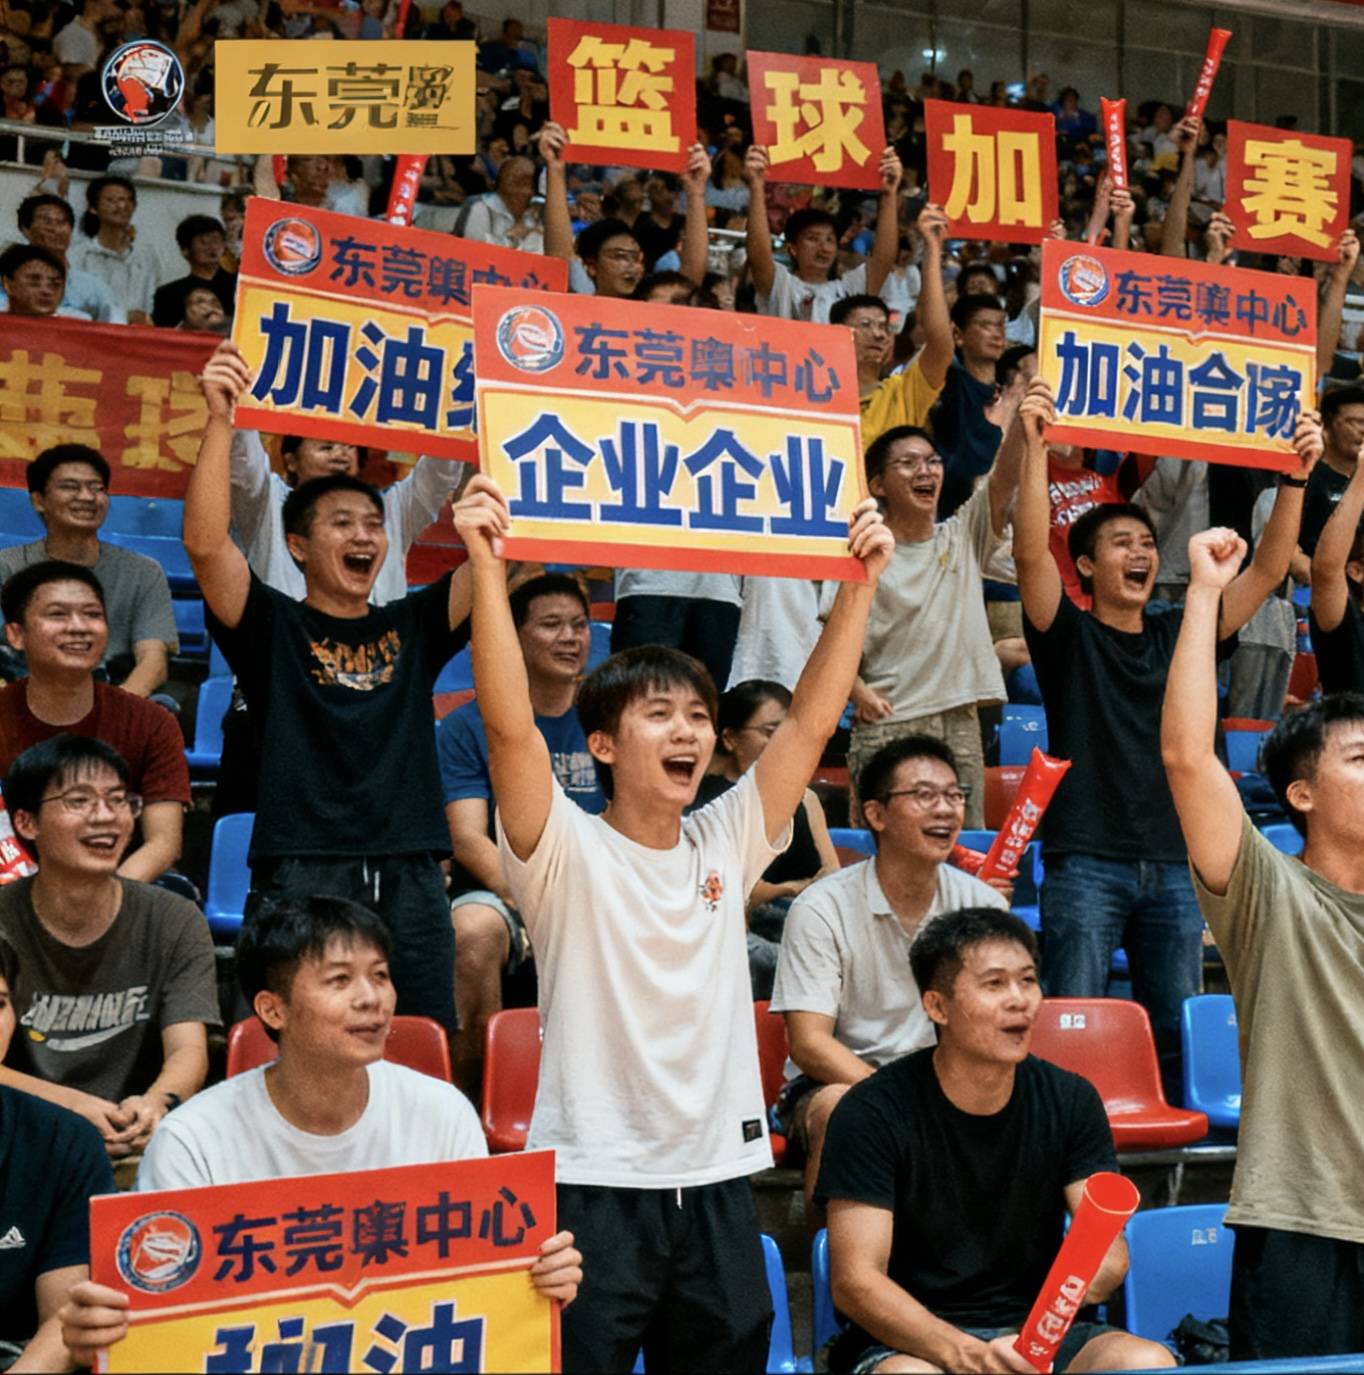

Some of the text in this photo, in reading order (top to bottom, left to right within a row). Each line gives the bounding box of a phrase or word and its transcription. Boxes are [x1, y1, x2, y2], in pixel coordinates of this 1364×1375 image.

[566, 35, 681, 154] 篮
[763, 68, 872, 173] 球
[942, 114, 1044, 228] 加
[1241, 139, 1339, 249] 赛
[502, 413, 850, 538] 企业企业
